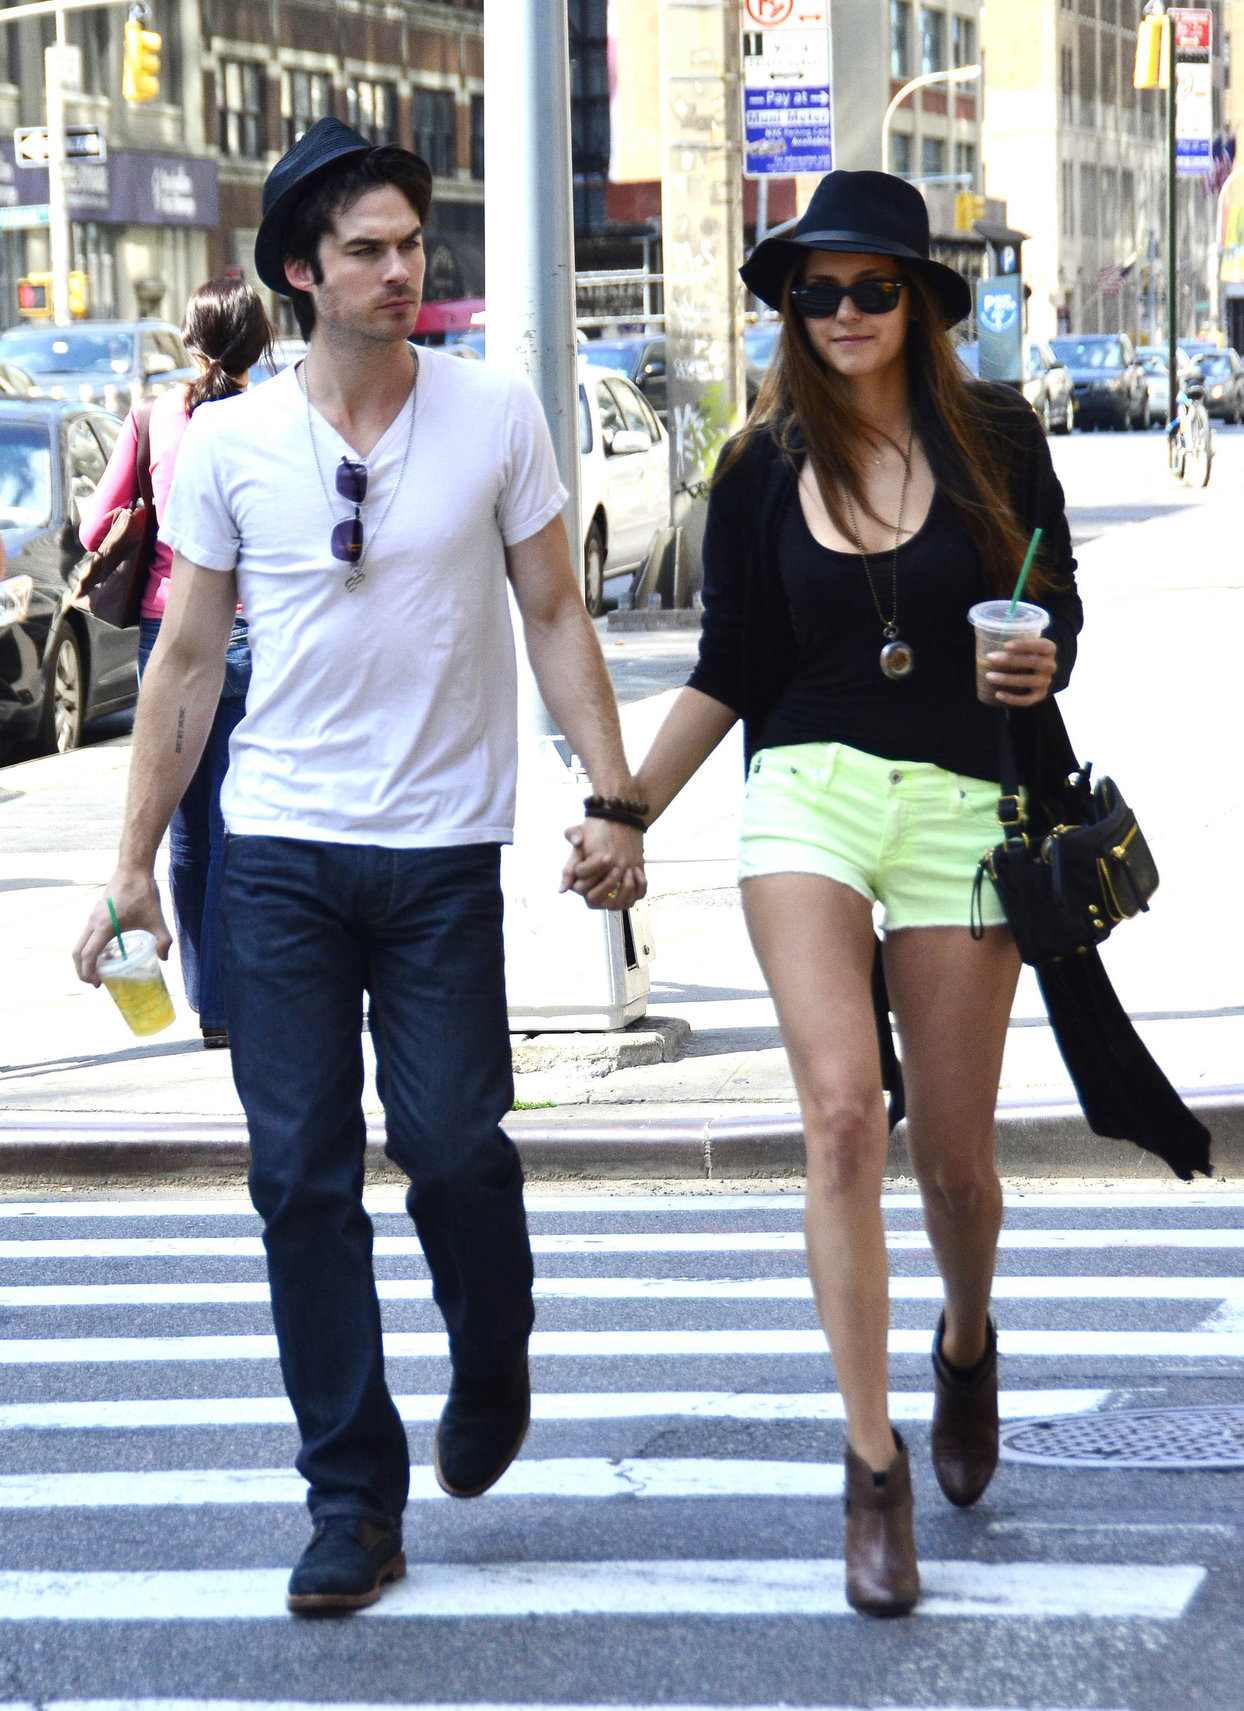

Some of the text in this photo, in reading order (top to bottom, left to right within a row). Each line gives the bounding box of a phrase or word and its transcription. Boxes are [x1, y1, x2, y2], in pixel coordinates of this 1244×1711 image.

[766, 90, 808, 107] Pay at
[1003, 246, 1015, 273] P
